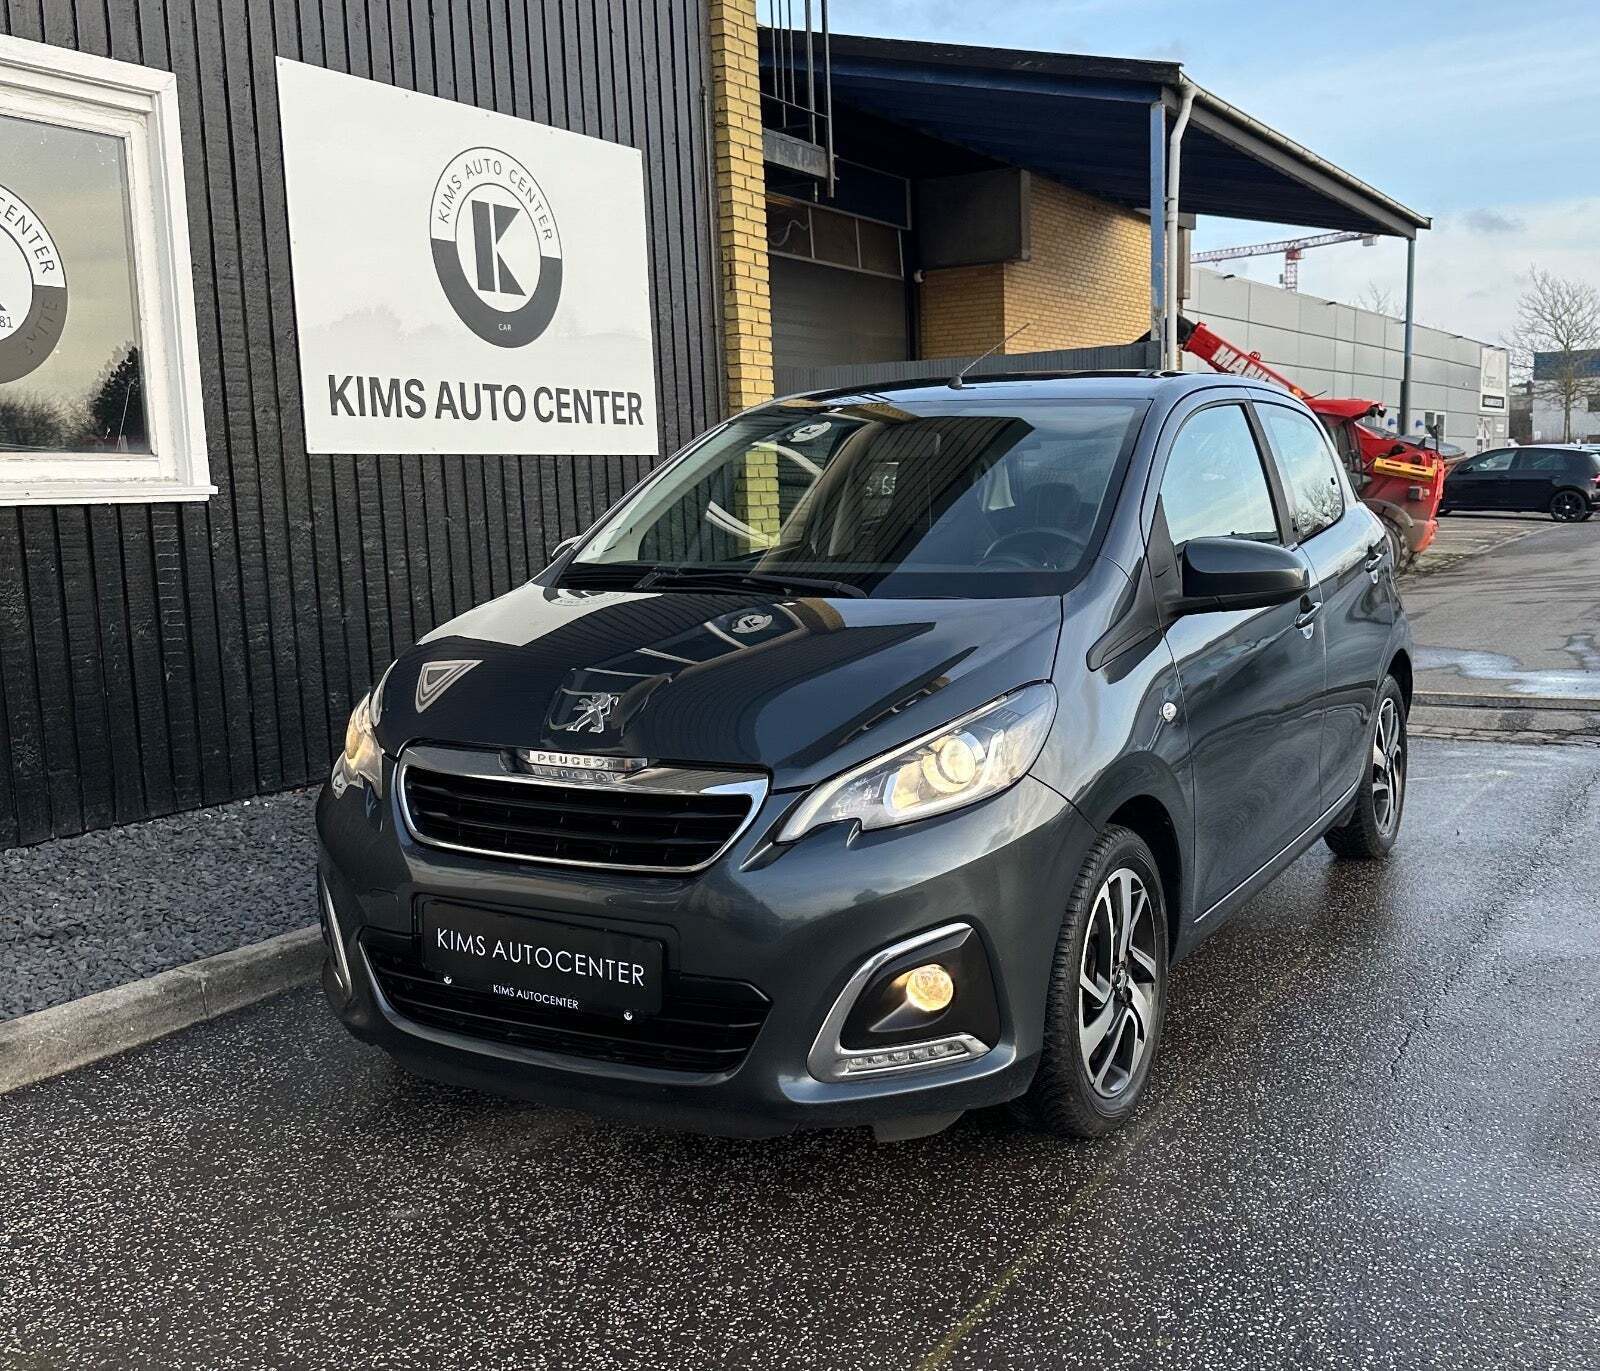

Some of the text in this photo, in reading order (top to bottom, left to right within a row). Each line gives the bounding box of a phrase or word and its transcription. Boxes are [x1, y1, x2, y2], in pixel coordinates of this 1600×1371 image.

[438, 158, 553, 241] KIMS AUTO CENTER
[471, 199, 527, 296] K
[498, 323, 512, 332] CAR
[328, 374, 645, 426] KIMS AUTO CENTER
[437, 927, 645, 987] KIMS AUTOCENTER
[493, 984, 579, 1010] KIMS AUTOCENTER
